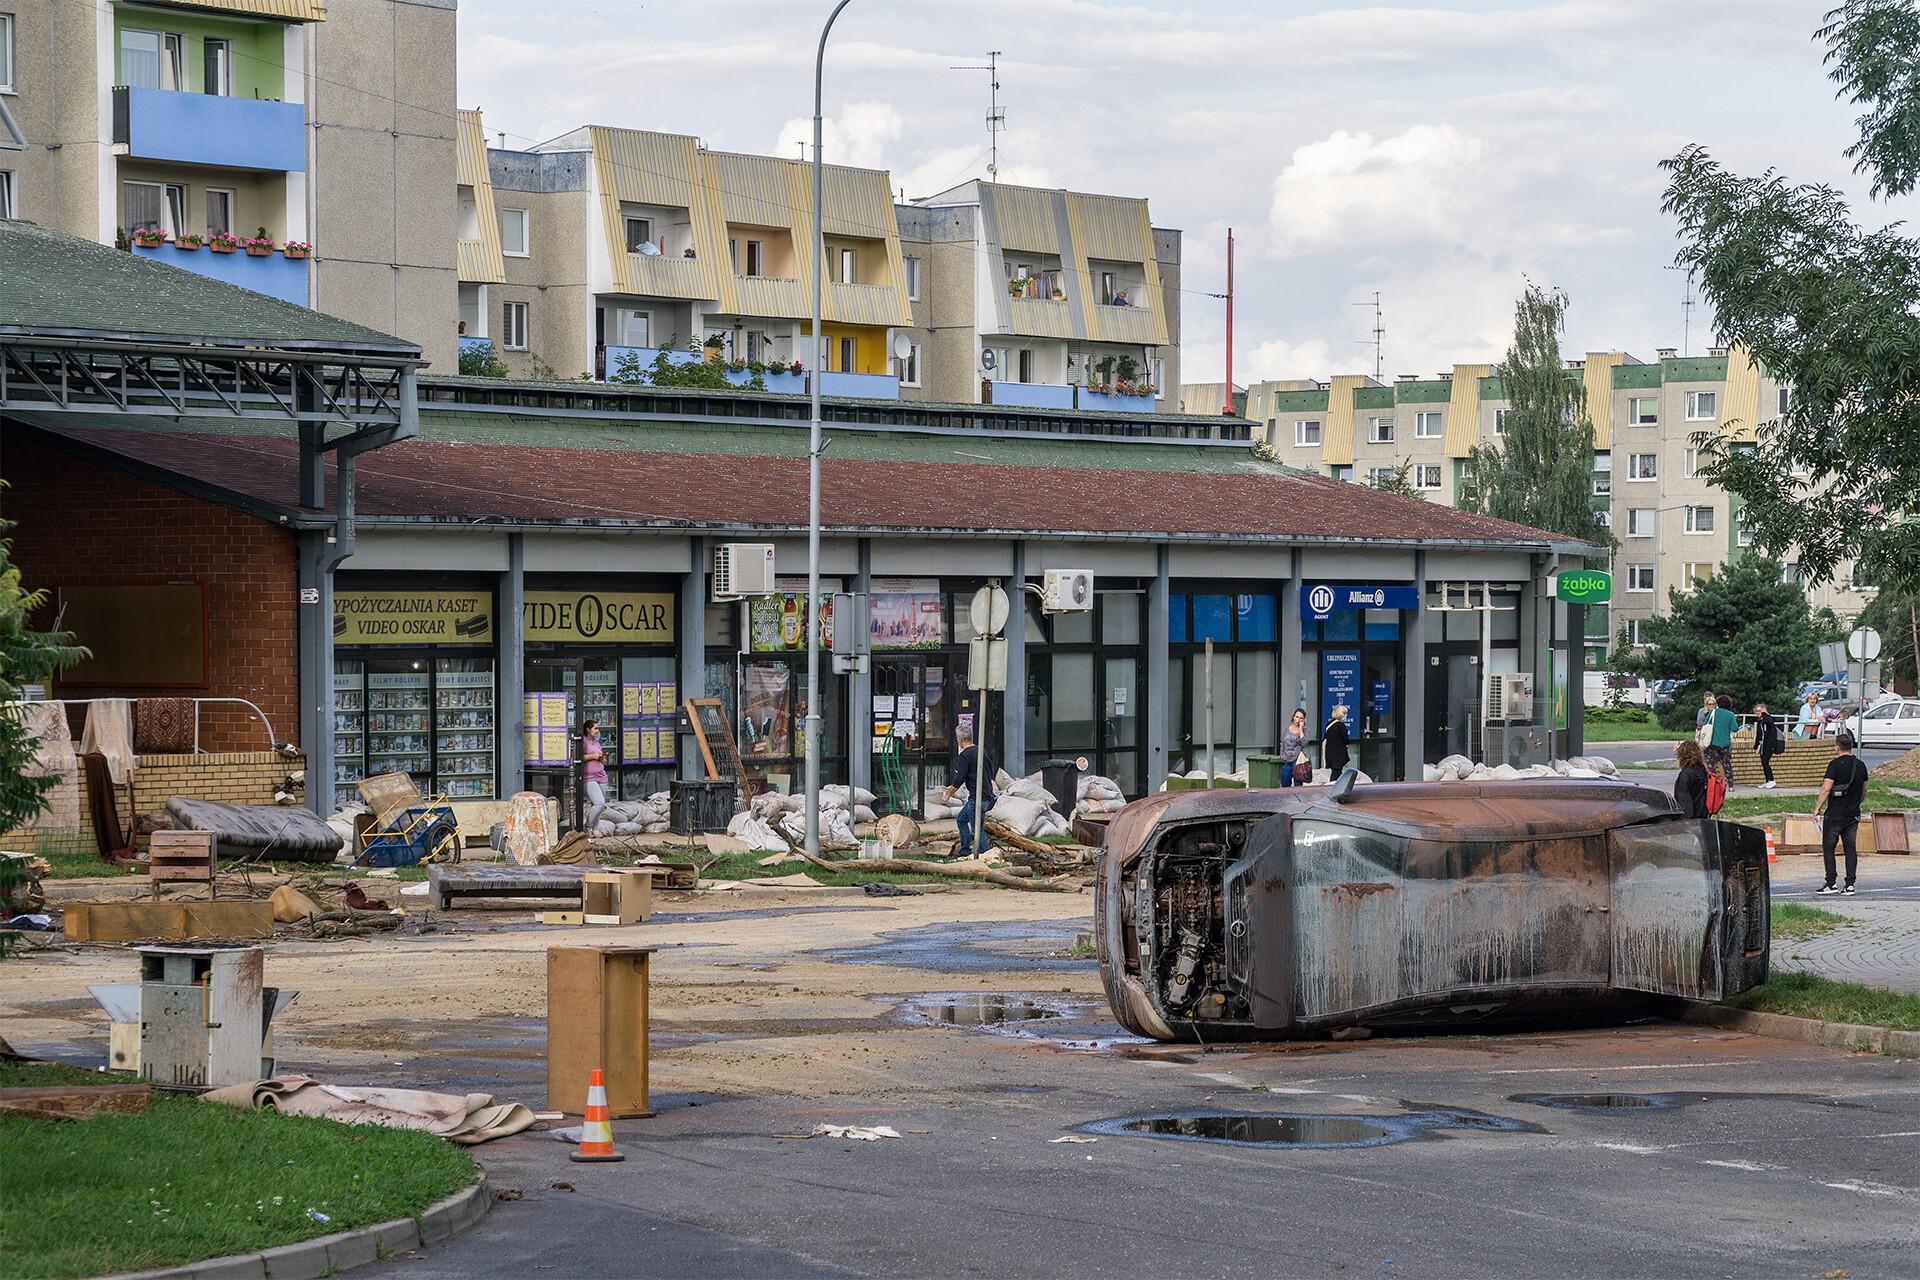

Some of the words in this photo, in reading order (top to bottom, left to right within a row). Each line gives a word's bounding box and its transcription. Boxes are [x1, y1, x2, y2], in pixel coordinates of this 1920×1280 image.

[1562, 576, 1606, 590] żabka
[333, 596, 433, 613] YPOŻYCZALNIA
[436, 598, 478, 613] KASET
[1348, 591, 1374, 603] Allianz
[357, 620, 399, 635] VIDEO
[402, 619, 445, 634] OSKAR
